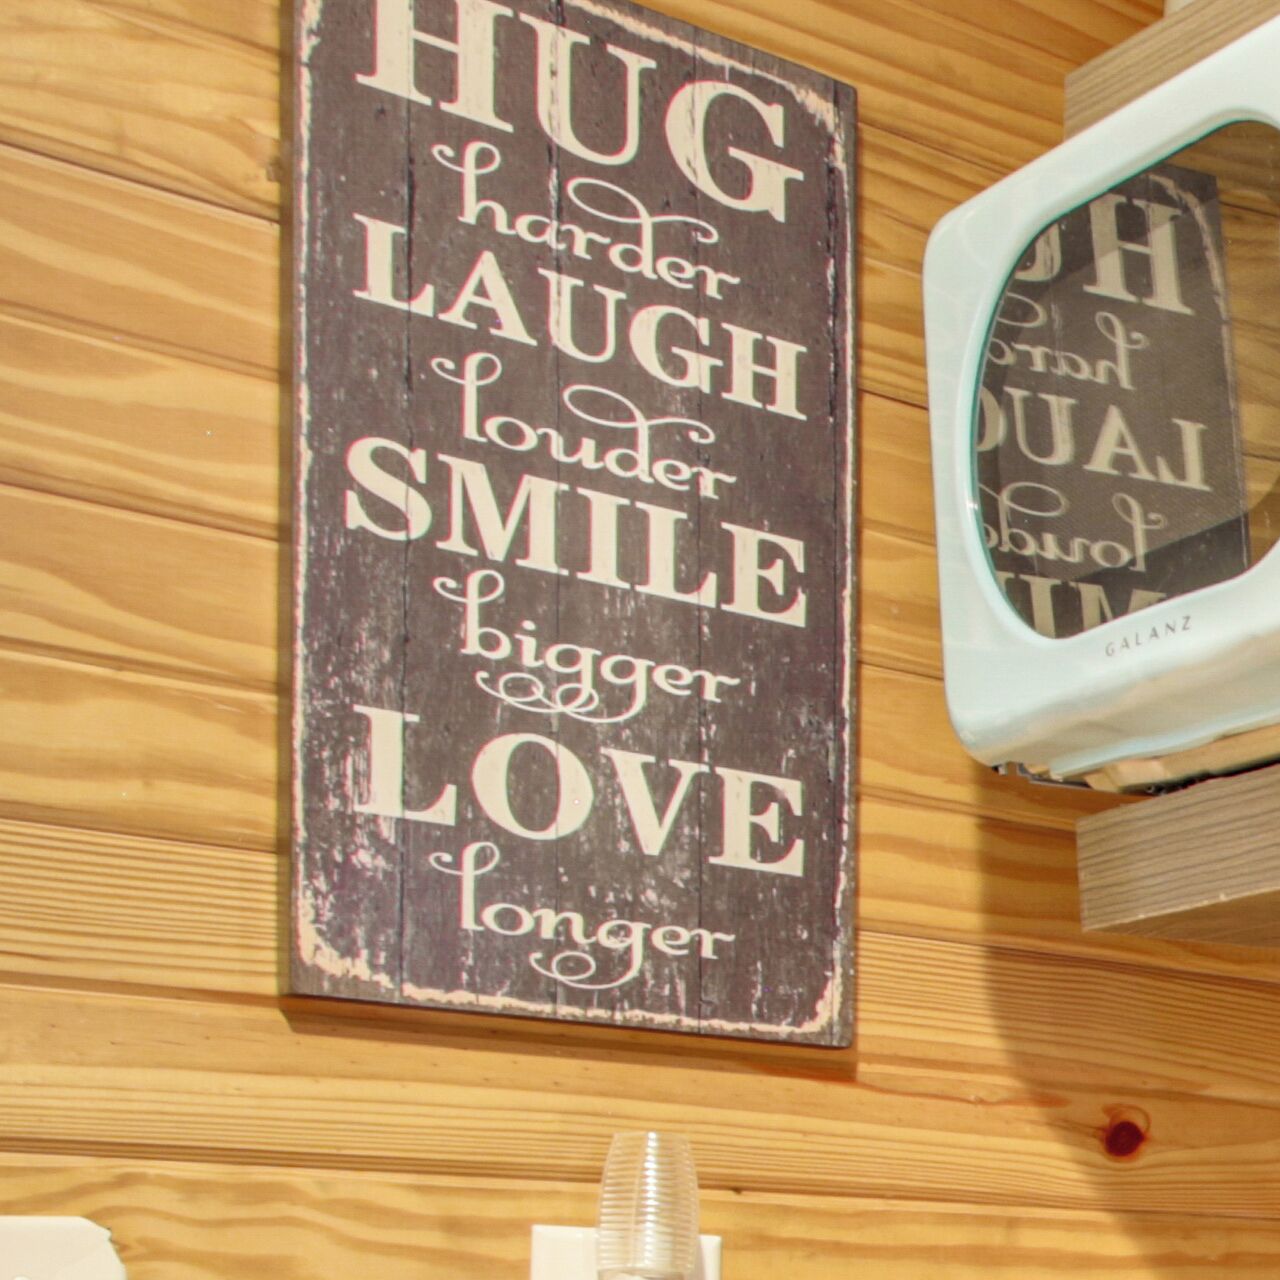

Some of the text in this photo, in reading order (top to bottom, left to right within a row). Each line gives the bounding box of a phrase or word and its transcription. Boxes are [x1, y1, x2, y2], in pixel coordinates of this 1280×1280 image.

[355, 0, 805, 223] HUG
[431, 141, 741, 299] harder
[353, 213, 808, 422] LAUGH
[431, 352, 737, 500] louder
[345, 437, 807, 628] SMILE
[433, 570, 741, 723] bigger
[1105, 614, 1191, 657] GALANZ
[352, 704, 805, 878] LOVE
[430, 841, 736, 989] longer
